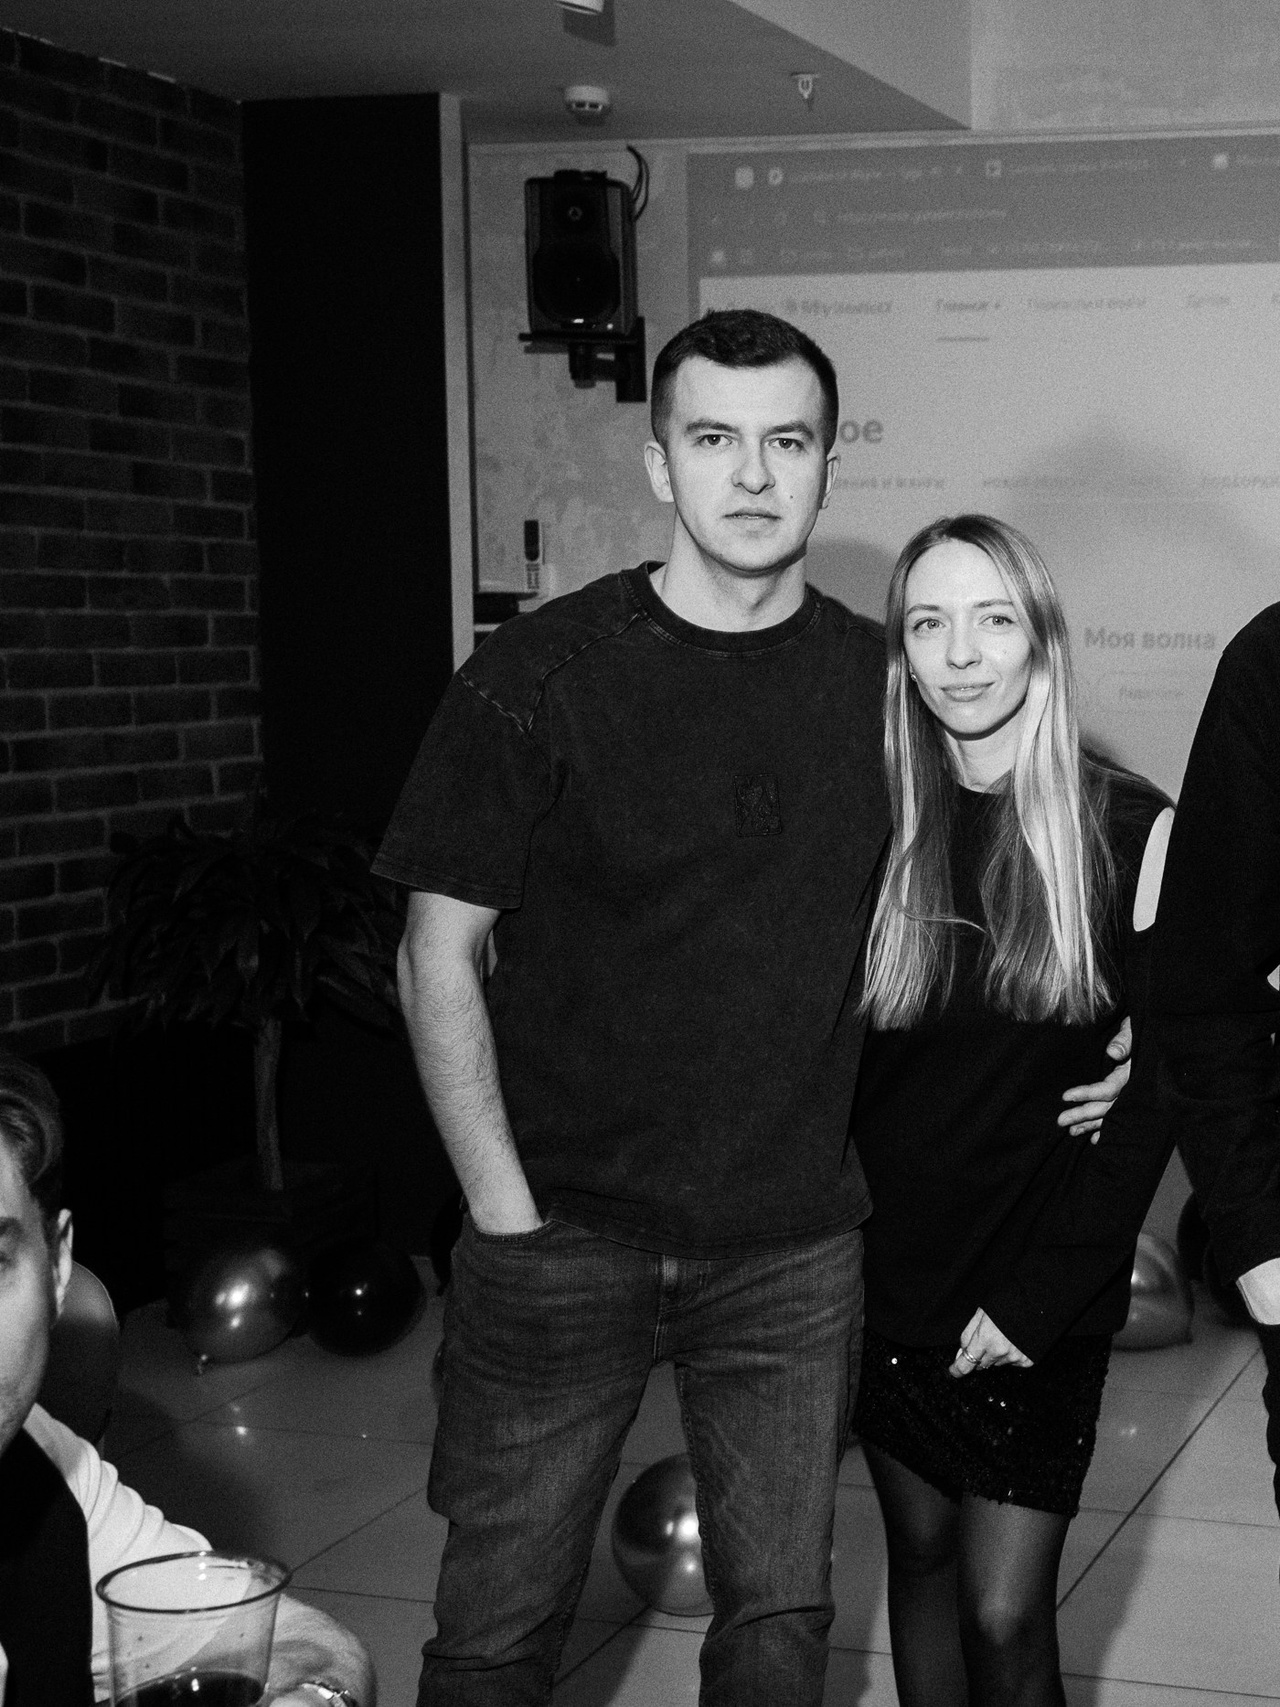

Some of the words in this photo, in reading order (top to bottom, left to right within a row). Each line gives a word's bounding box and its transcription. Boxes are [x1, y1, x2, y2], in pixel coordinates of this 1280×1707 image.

[839, 419, 884, 444] ое
[1085, 627, 1135, 649] Моя
[1142, 631, 1216, 650] волна
